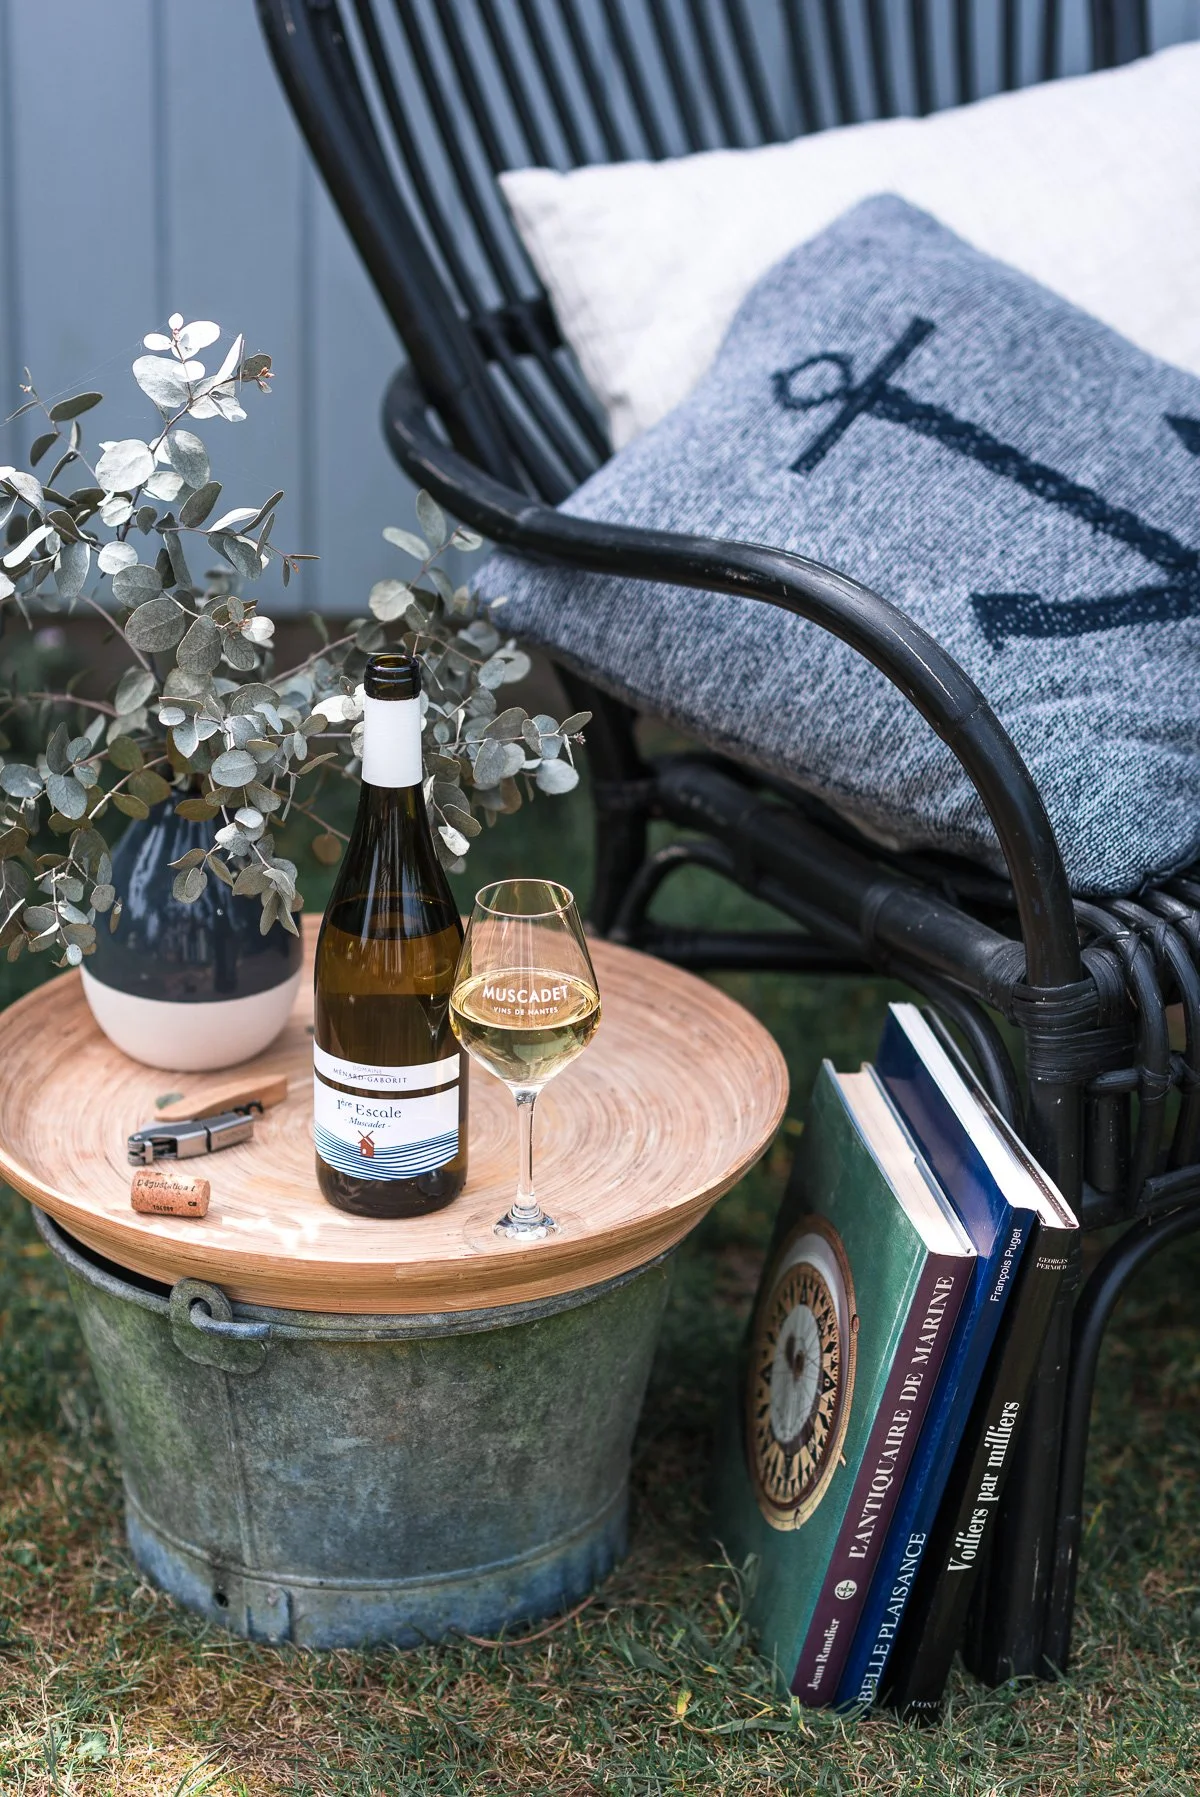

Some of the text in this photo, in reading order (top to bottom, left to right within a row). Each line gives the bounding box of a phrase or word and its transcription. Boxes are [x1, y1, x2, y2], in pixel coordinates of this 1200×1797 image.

[482, 984, 569, 1004] MUSCADET
[493, 1006, 559, 1016] VINS DE NANTES
[352, 1065, 382, 1074] DOMAINE
[355, 1103, 402, 1119] Escale
[348, 1116, 386, 1129] Muscadet
[989, 1228, 1023, 1302] François Puget
[1038, 1256, 1068, 1264] GEORGES
[848, 1275, 955, 1559] L'ANTIQUAIRE DE MARINE
[946, 1401, 1020, 1572] Voiliers par milliers
[857, 1532, 927, 1702] BELLE PLAISANCE
[807, 1618, 841, 1691] Jean Randier
